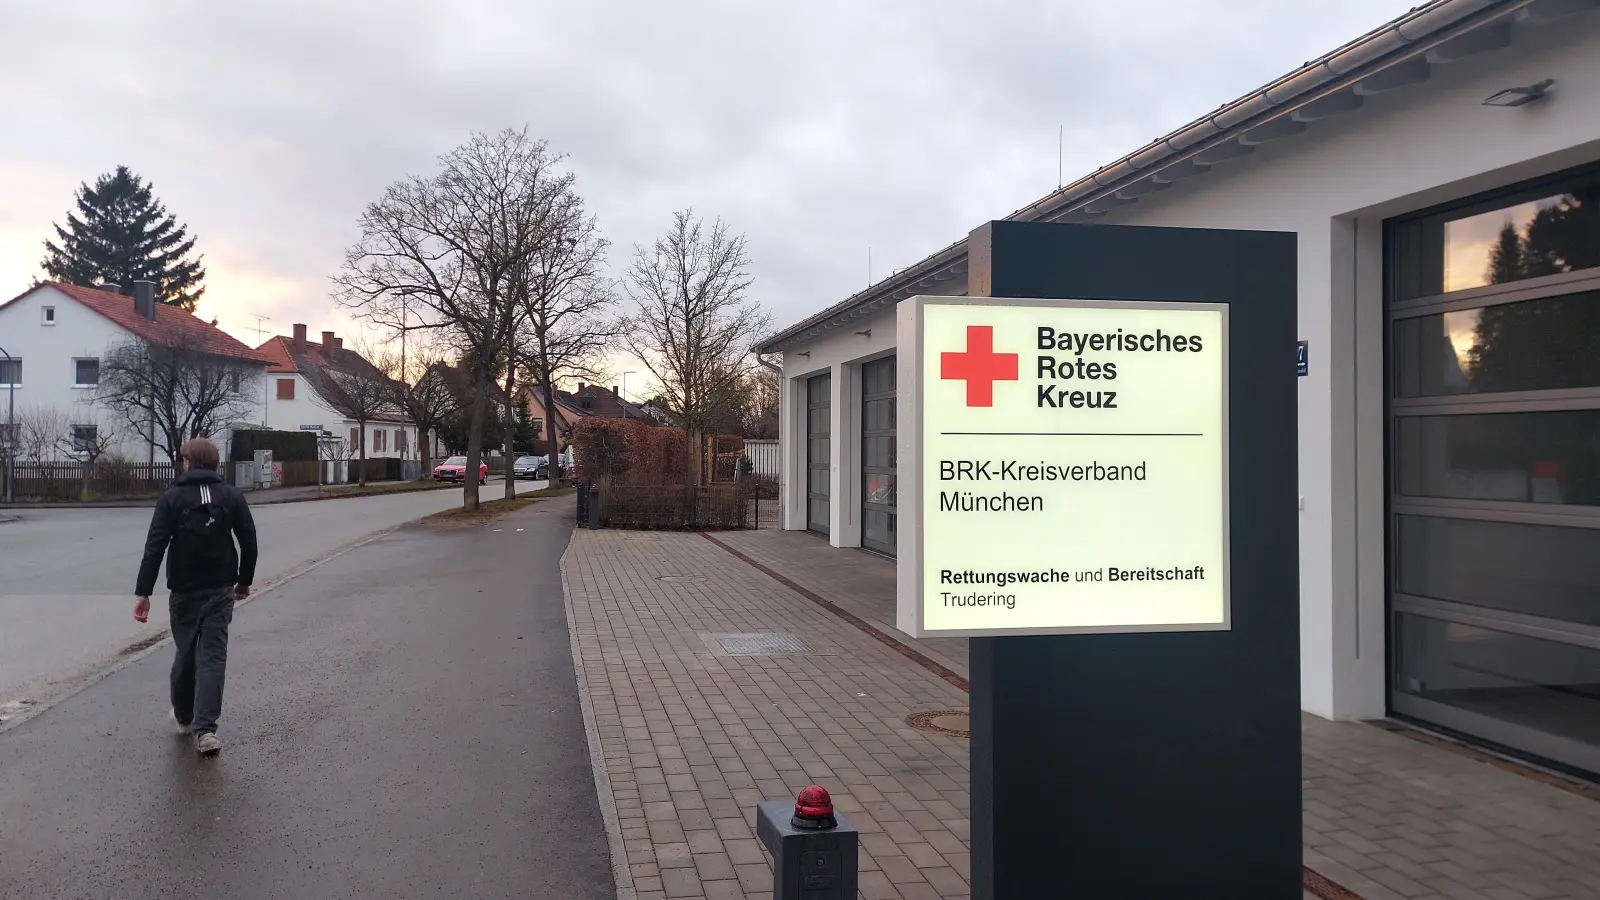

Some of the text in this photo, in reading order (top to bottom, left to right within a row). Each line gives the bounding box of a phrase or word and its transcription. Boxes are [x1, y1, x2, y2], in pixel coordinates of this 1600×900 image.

[1037, 326, 1203, 356] Bayerisches
[1037, 355, 1118, 381] Rotes
[1037, 384, 1118, 409] Kreuz
[940, 460, 1147, 481] BRK-Kreisverband
[940, 491, 1044, 512] München
[940, 565, 1206, 588] Rettungswache und Bereitschaft
[940, 591, 1017, 610] Trudering
